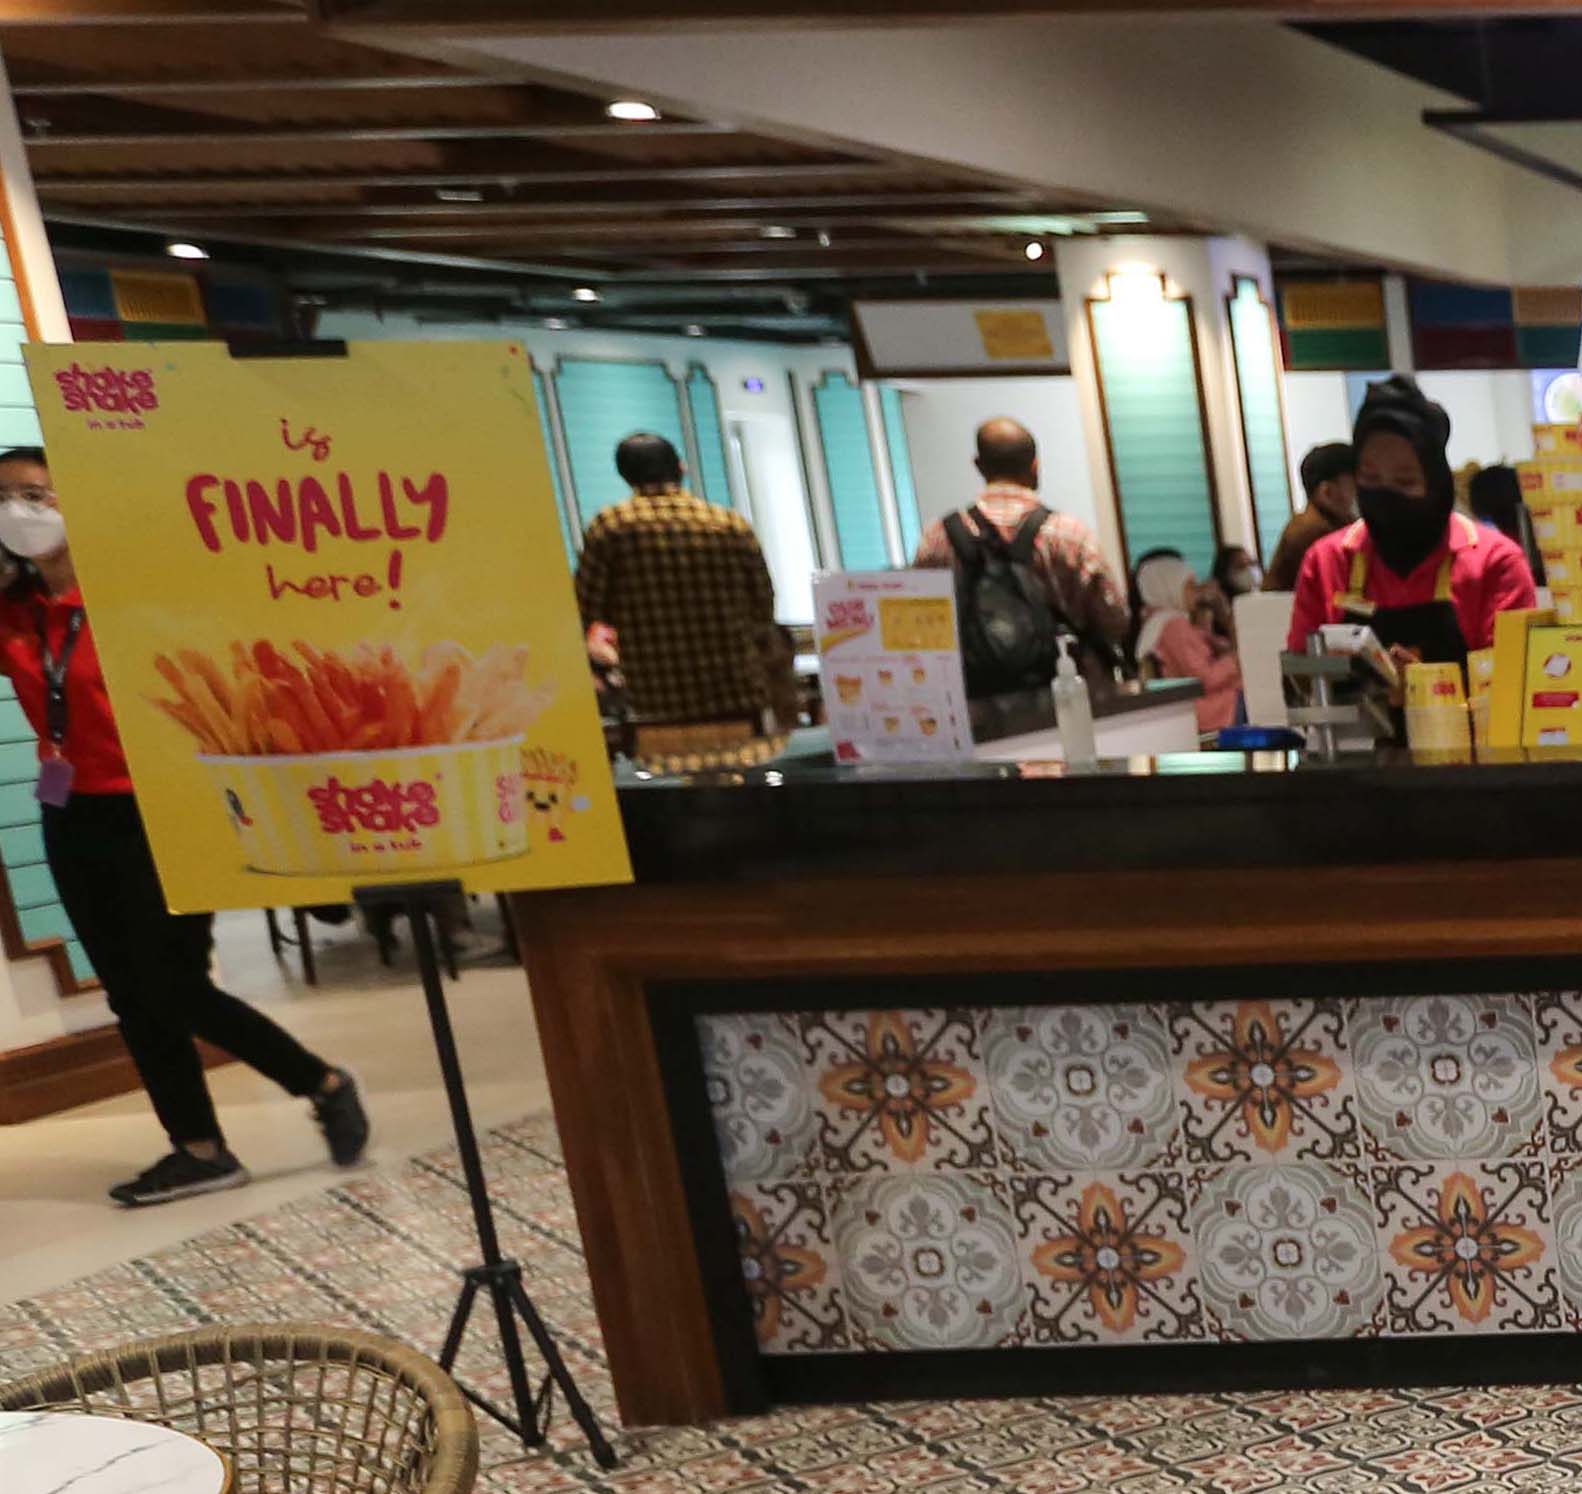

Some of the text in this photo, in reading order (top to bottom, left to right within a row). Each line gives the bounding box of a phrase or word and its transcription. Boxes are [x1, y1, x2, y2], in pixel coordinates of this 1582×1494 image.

[280, 417, 332, 461] is
[186, 470, 448, 553] FINALLY
[266, 549, 401, 610] here!
